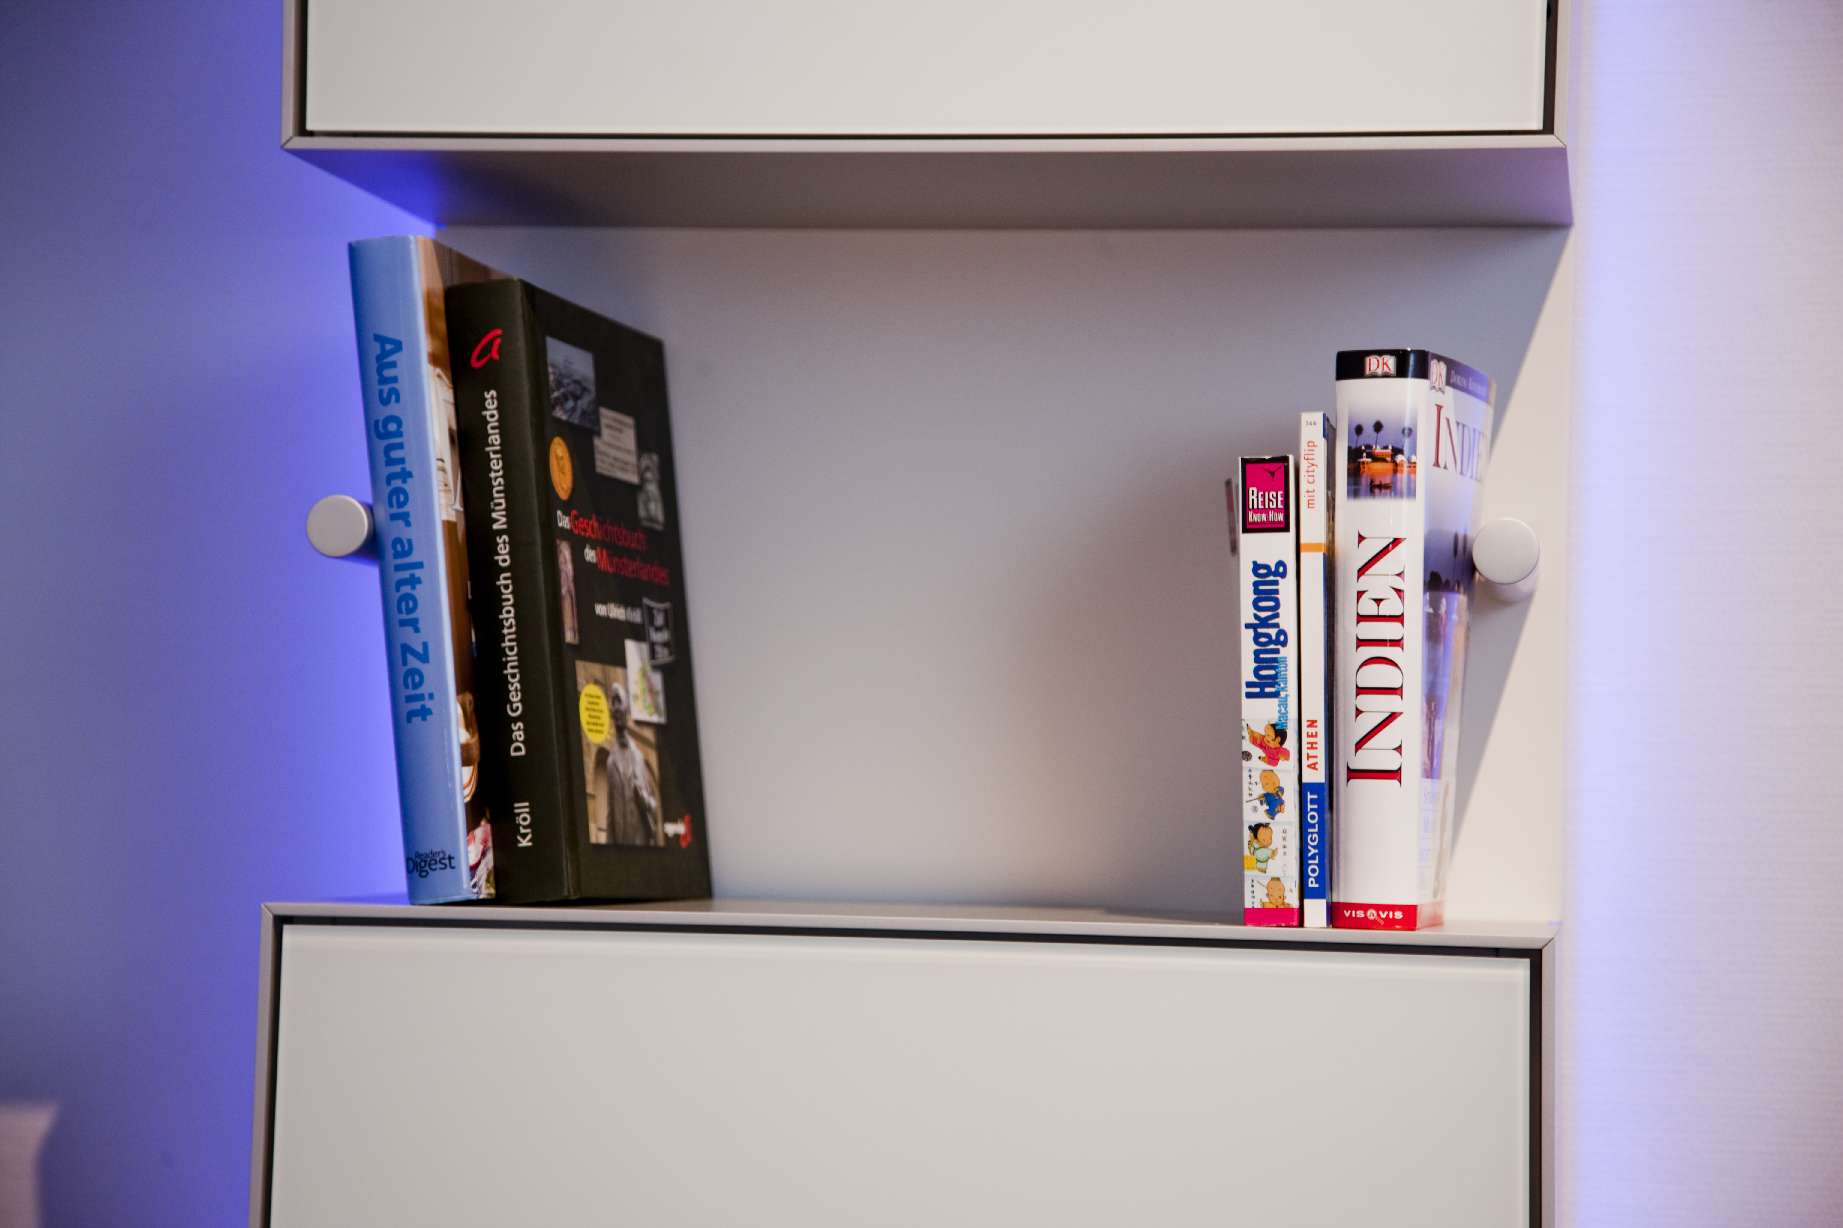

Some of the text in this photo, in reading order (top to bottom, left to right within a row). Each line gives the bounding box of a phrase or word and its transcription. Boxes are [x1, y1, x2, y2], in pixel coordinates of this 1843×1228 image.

[1366, 356, 1392, 373] DK
[1303, 440, 1318, 509] mit cityflip
[373, 333, 434, 724] Aus guter alter Zeit
[478, 389, 533, 847] Kröll Das Geschichtsbuch des Münsterlandes
[1245, 560, 1288, 699] Hongkong
[1346, 530, 1407, 787] INDIEN
[1306, 719, 1319, 771] ATHEN
[406, 853, 456, 878] Digest
[1307, 792, 1319, 888] POLYGLOTT
